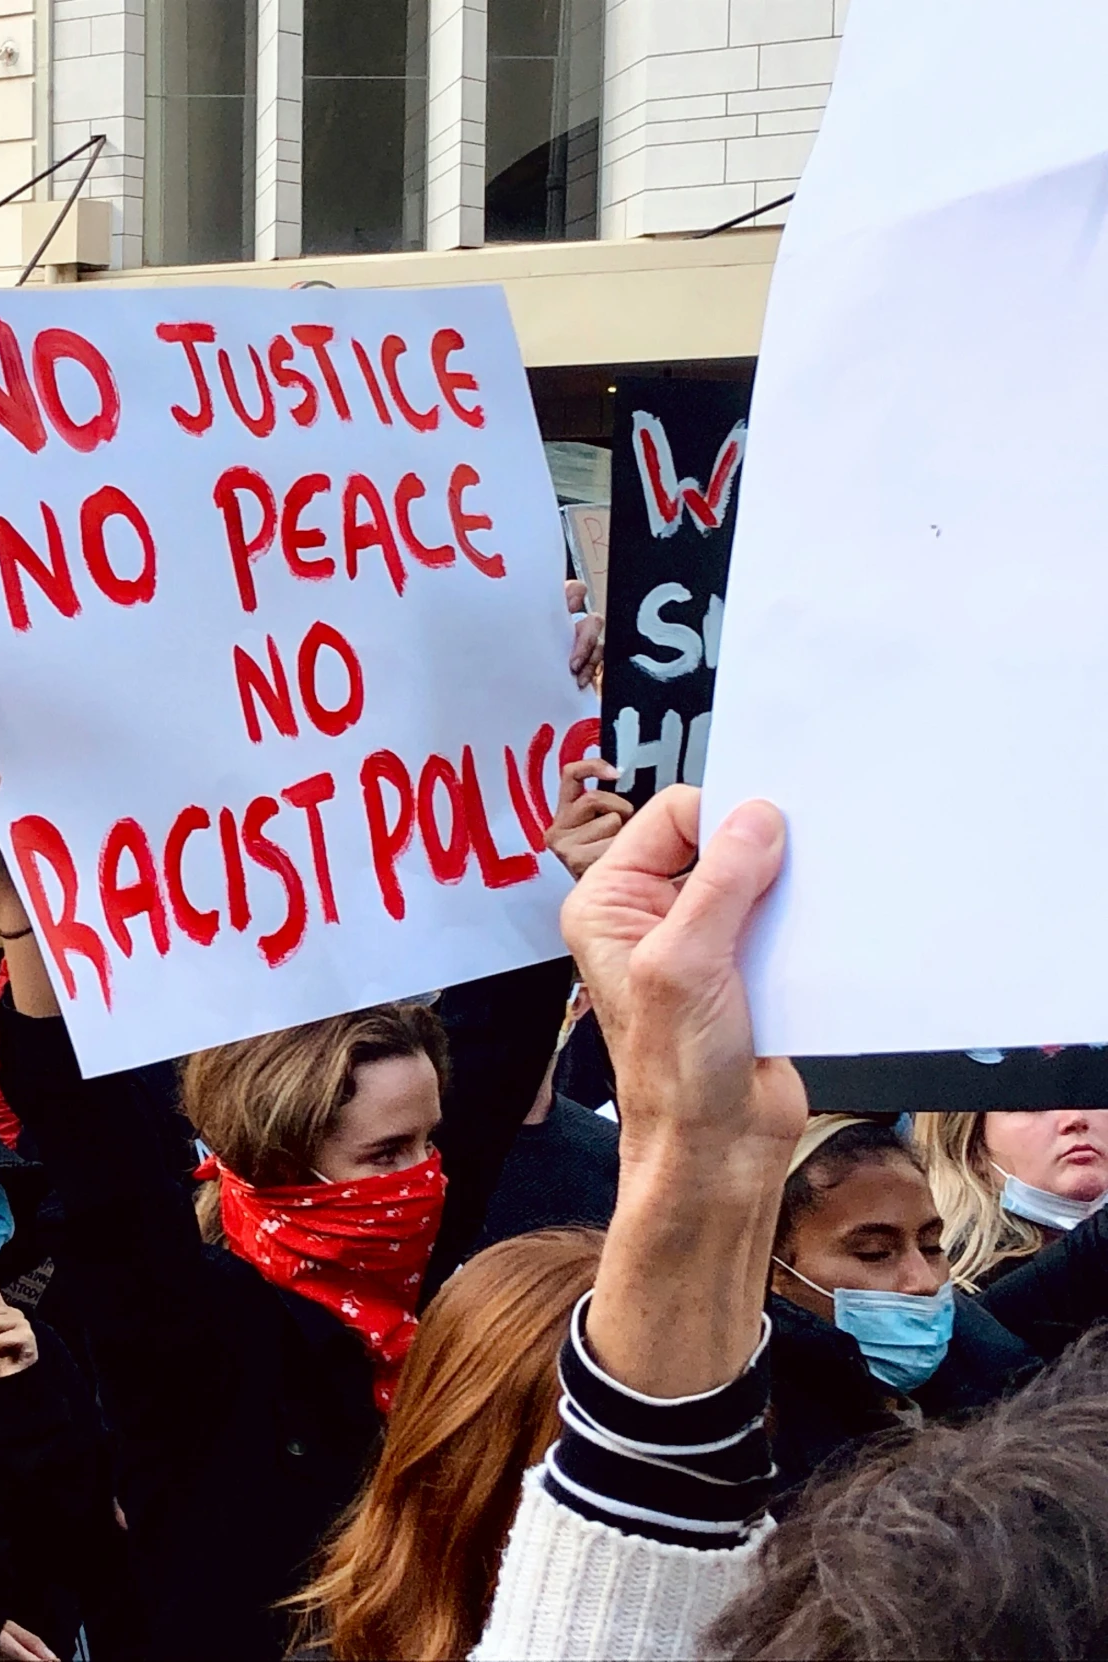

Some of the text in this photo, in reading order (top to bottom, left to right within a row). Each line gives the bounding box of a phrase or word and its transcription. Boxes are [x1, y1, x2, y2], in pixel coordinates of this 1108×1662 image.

[155, 321, 486, 440] JUSTICE
[212, 463, 507, 614] PEACE
[233, 619, 365, 745] NO
[9, 772, 341, 1014] RACIST
